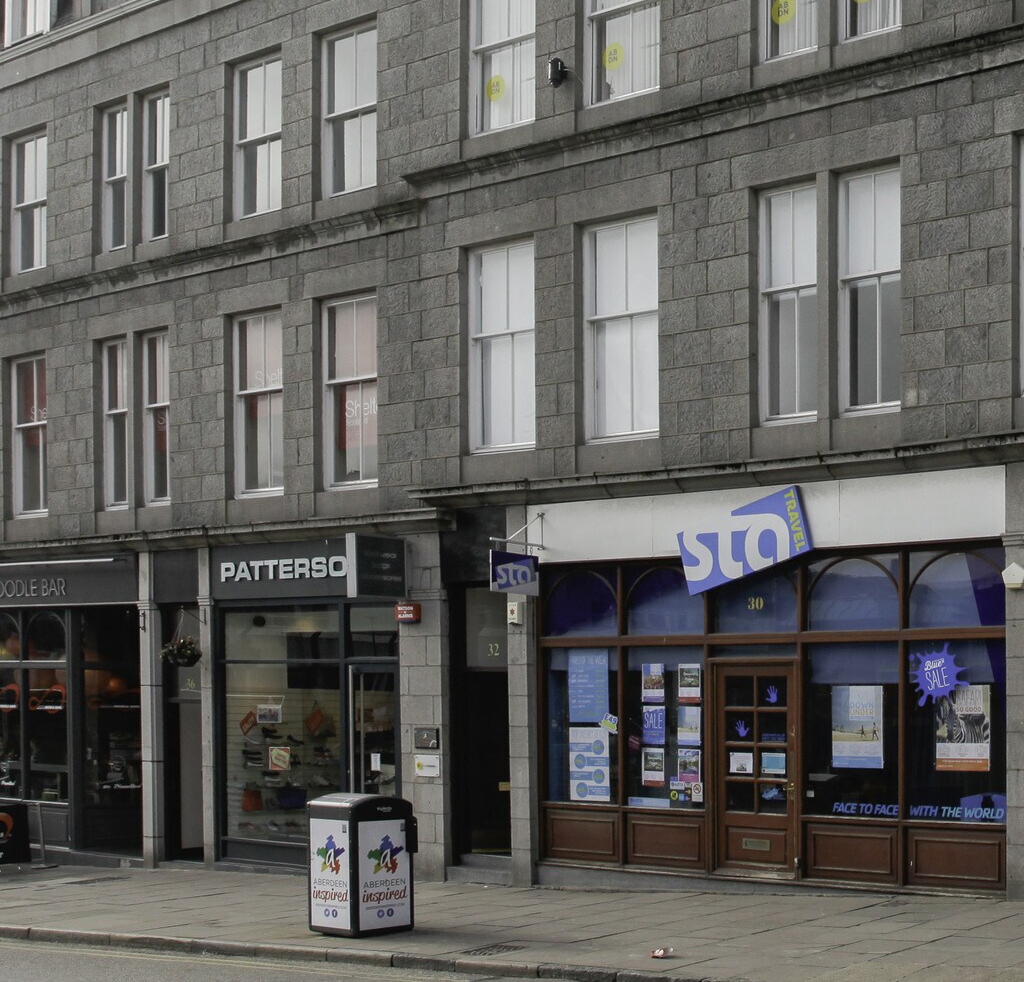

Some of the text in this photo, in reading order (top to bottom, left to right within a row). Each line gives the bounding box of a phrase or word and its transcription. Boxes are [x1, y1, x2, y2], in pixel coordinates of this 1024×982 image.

[345, 397, 378, 418] Shelt
[783, 489, 806, 552] TRAVEL
[220, 555, 347, 583] PATTERSO
[41, 578, 66, 596] BAR
[747, 596, 764, 610] 30
[487, 643, 500, 657] 32
[925, 667, 950, 691] SALE
[644, 712, 663, 729] SALE
[832, 802, 1004, 819] FACE TO FACE WITH THE WORLD
[313, 878, 348, 888] ABERDEEN
[363, 878, 406, 889] ABERDEEN
[312, 886, 349, 903] inspired
[362, 886, 408, 904] inspired
